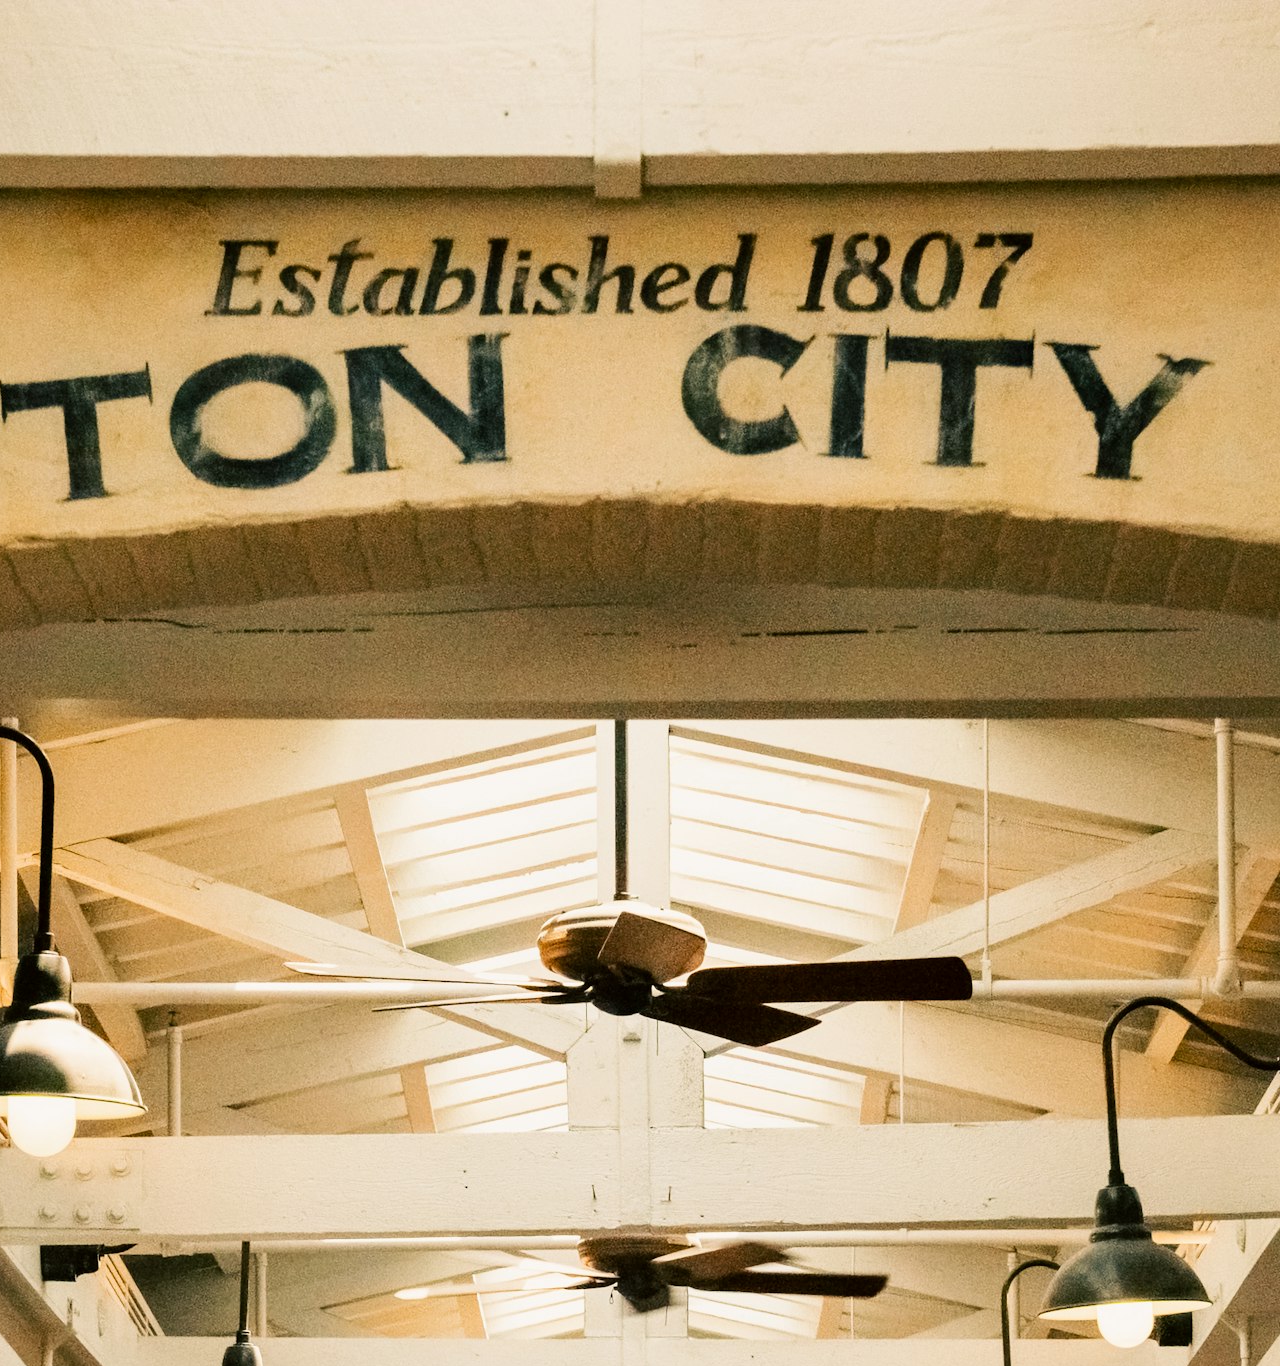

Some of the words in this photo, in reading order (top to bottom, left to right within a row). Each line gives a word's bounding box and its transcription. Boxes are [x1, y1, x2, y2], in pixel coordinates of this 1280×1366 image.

[204, 234, 757, 316] Established
[797, 232, 1034, 313] 1807
[681, 324, 1214, 481] CITY
